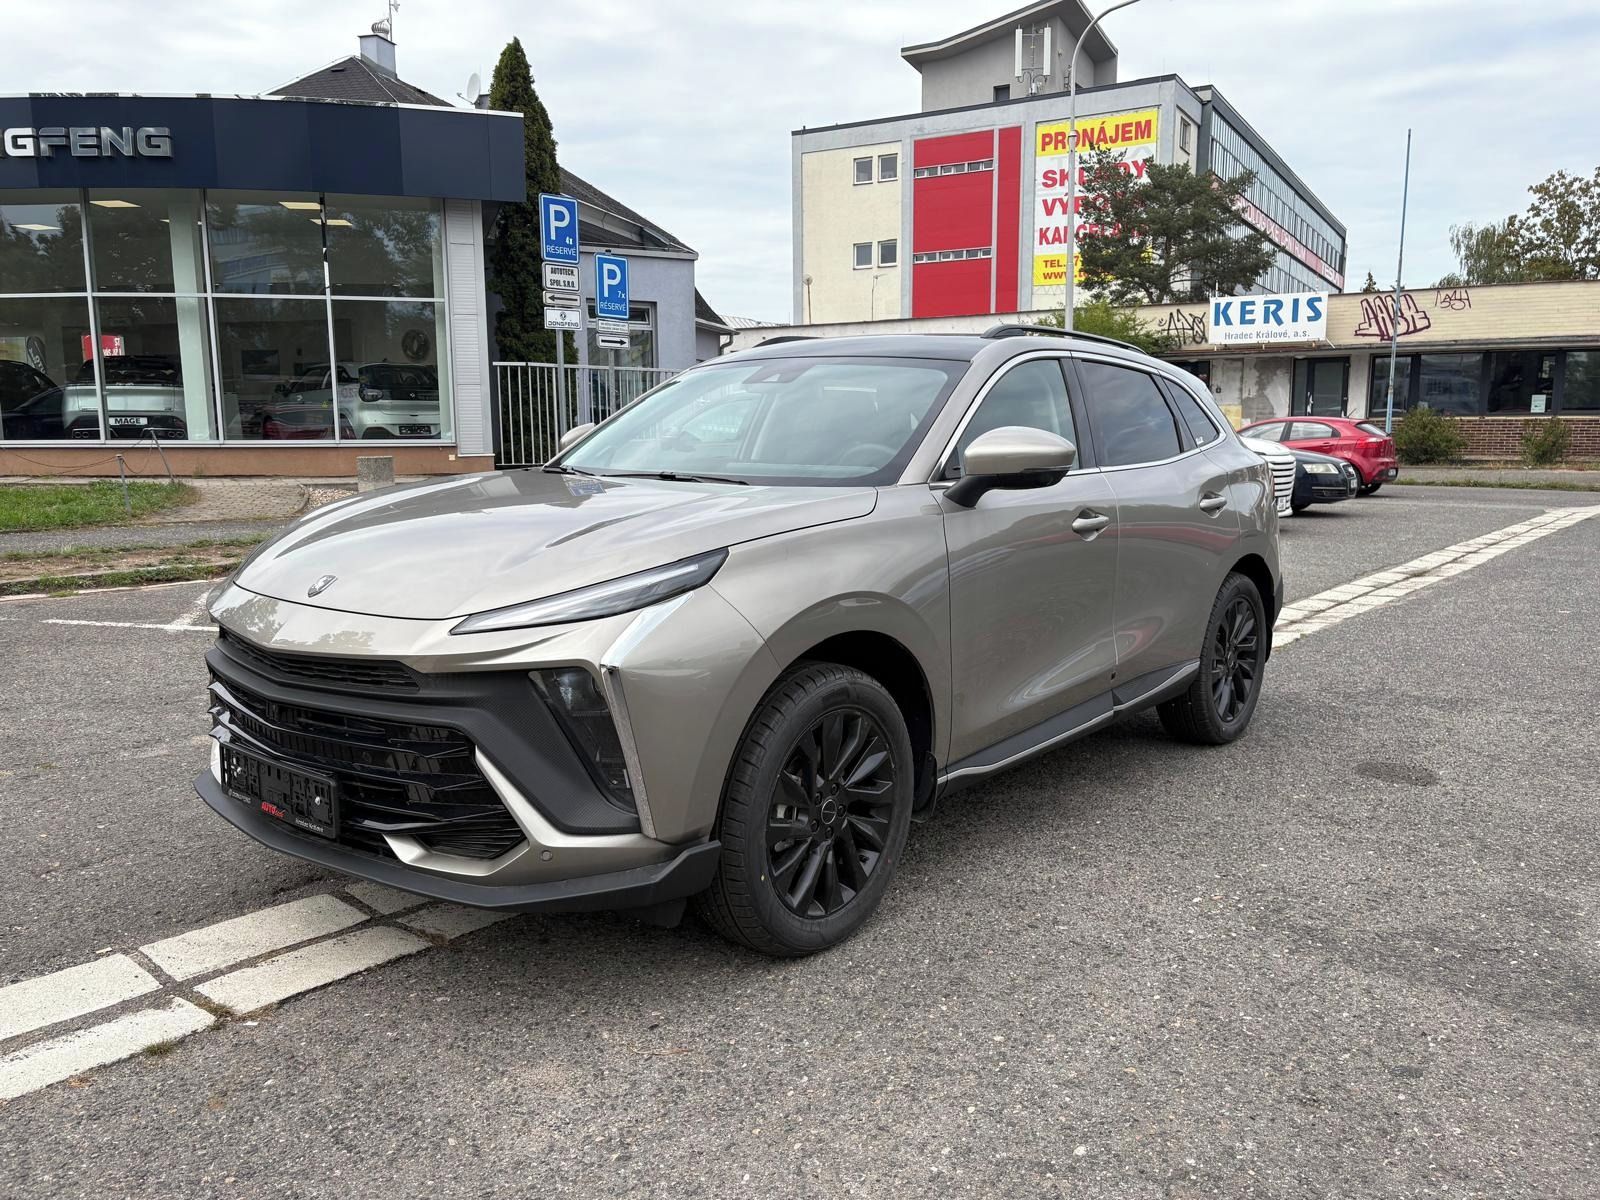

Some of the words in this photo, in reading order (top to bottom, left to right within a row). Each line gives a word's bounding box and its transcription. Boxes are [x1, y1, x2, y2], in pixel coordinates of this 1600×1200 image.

[0, 127, 172, 157] GFENG
[1041, 120, 1153, 152] PRONÁJEM
[1041, 159, 1148, 188] SKLDY
[549, 203, 570, 241] P
[602, 262, 622, 298] P
[599, 300, 627, 312] RÉSERVÉ
[617, 291, 626, 299] 7x
[1213, 296, 1323, 327] KERIS
[1224, 330, 1254, 341] Hradec
[1255, 328, 1291, 340] Králové,
[1293, 330, 1310, 338] a.s.
[114, 417, 141, 425] MAGE
